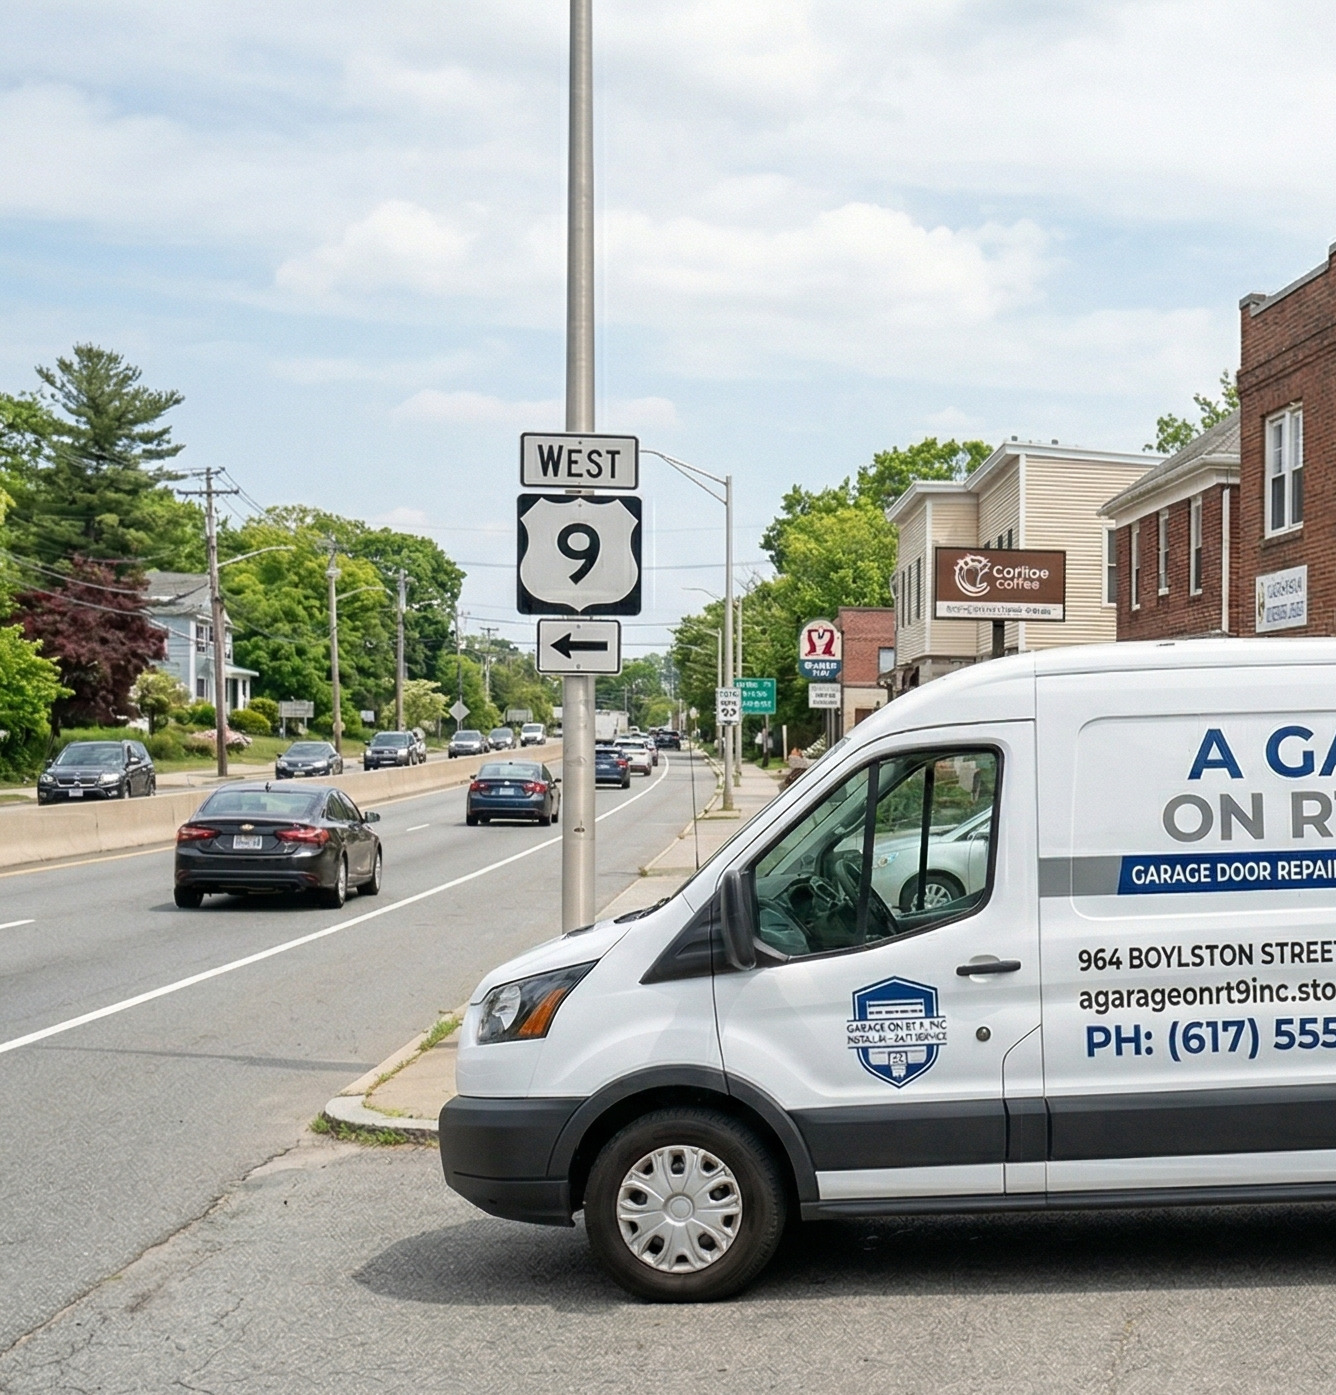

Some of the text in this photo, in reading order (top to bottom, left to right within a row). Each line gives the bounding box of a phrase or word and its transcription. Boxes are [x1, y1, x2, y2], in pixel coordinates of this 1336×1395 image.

[538, 444, 621, 479] WEST
[556, 522, 601, 585] 9
[1187, 728, 1244, 780] A
[1162, 792, 1265, 843] ON
[1132, 863, 1211, 884] GARAGE
[1217, 861, 1272, 882] DOOR
[1078, 949, 1123, 971] 964
[1129, 943, 1254, 969] BOYLSTON
[1086, 1023, 1153, 1058] PH:
[1168, 1017, 1259, 1062] (617)
